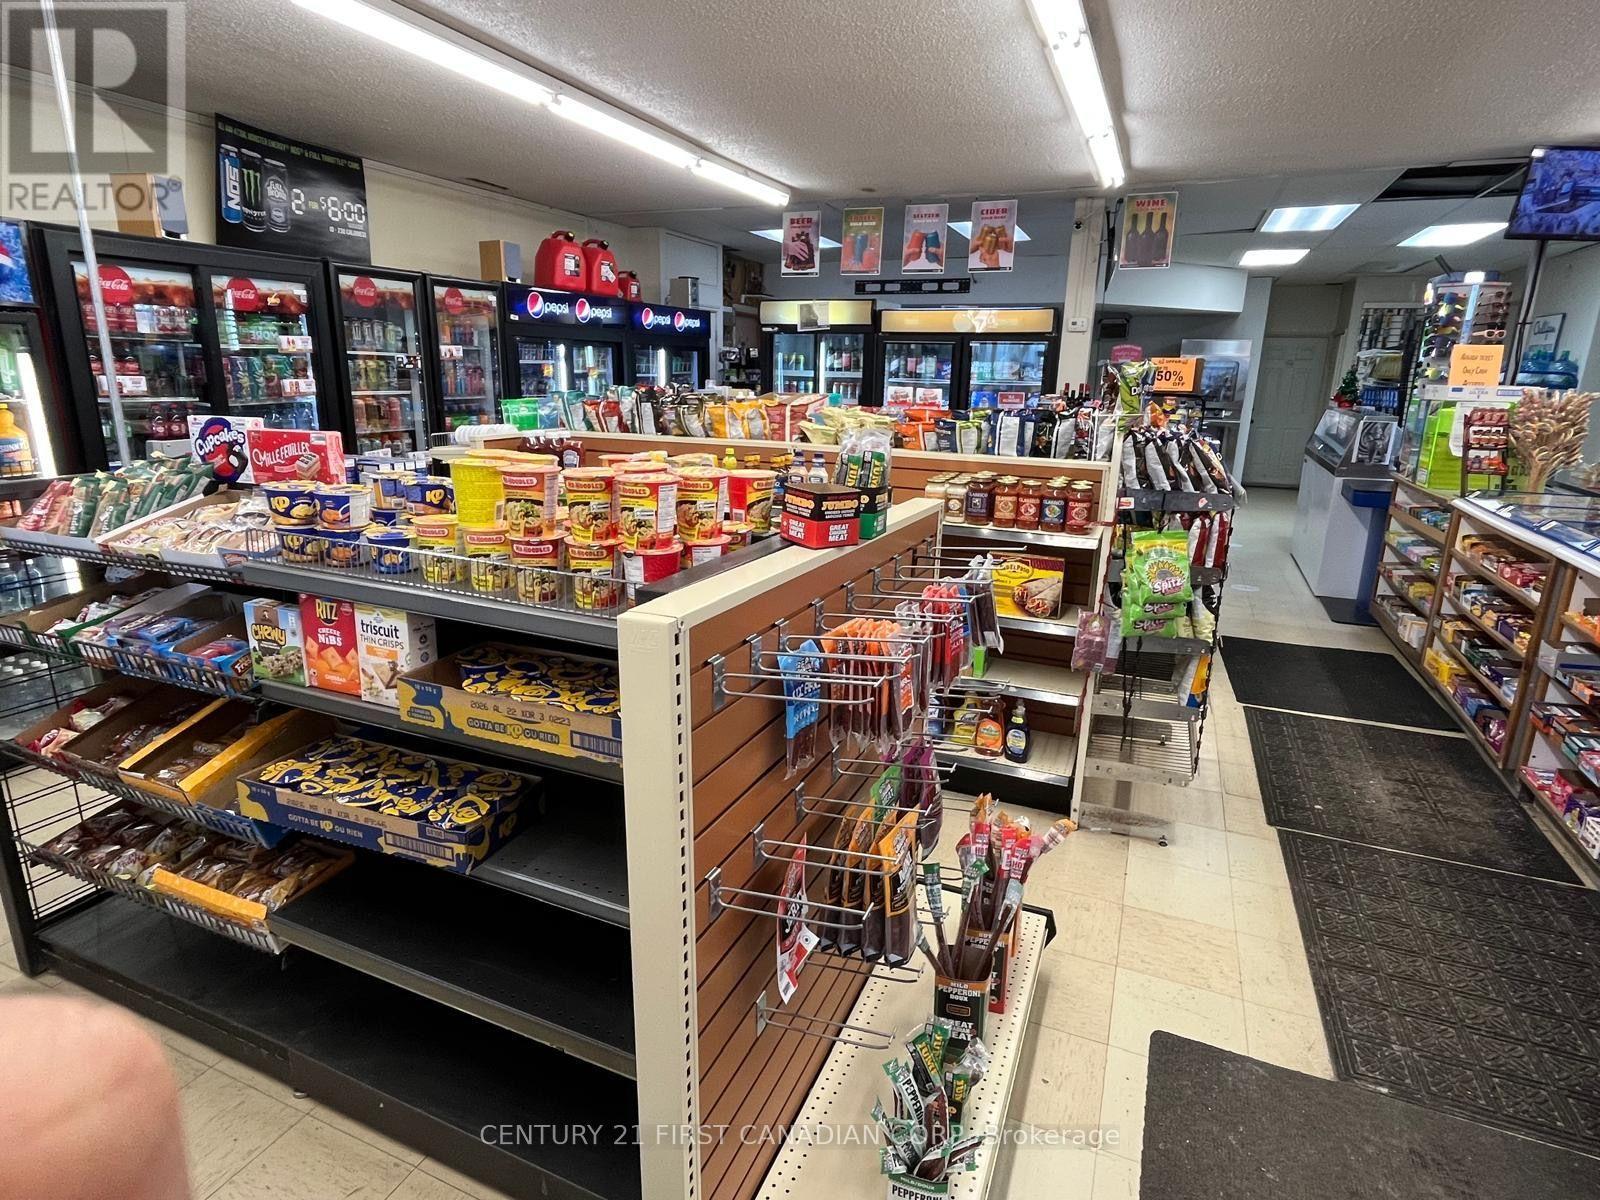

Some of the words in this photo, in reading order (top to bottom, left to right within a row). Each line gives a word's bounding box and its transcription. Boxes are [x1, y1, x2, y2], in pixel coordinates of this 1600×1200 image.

[291, 188, 305, 215] 2
[1136, 199, 1168, 207] WINE
[980, 207, 1008, 216] CIDER
[789, 217, 813, 225] BEER
[99, 278, 129, 291] oca-Cola
[544, 300, 569, 316] pepsi
[590, 306, 612, 320] pepsi
[653, 314, 671, 326] pepsi
[683, 318, 700, 329] pepsi
[1156, 370, 1184, 382] 50%
[195, 428, 245, 456] Cupcakes
[828, 533, 849, 542] MEAT
[1152, 576, 1185, 594] Spitz
[315, 600, 339, 620] RITZ
[360, 619, 400, 640] triscuit
[360, 634, 377, 645] THIN
[378, 638, 405, 650] CRISPS
[467, 718, 493, 730] GOTTA
[524, 730, 538, 739] OU
[539, 733, 560, 744] RIEN
[287, 813, 309, 825] GOTTA
[938, 984, 981, 998] PEPPERONI
[950, 981, 969, 989] MILD
[949, 994, 969, 1002] DOUX
[891, 1184, 943, 1200] PEPPER
